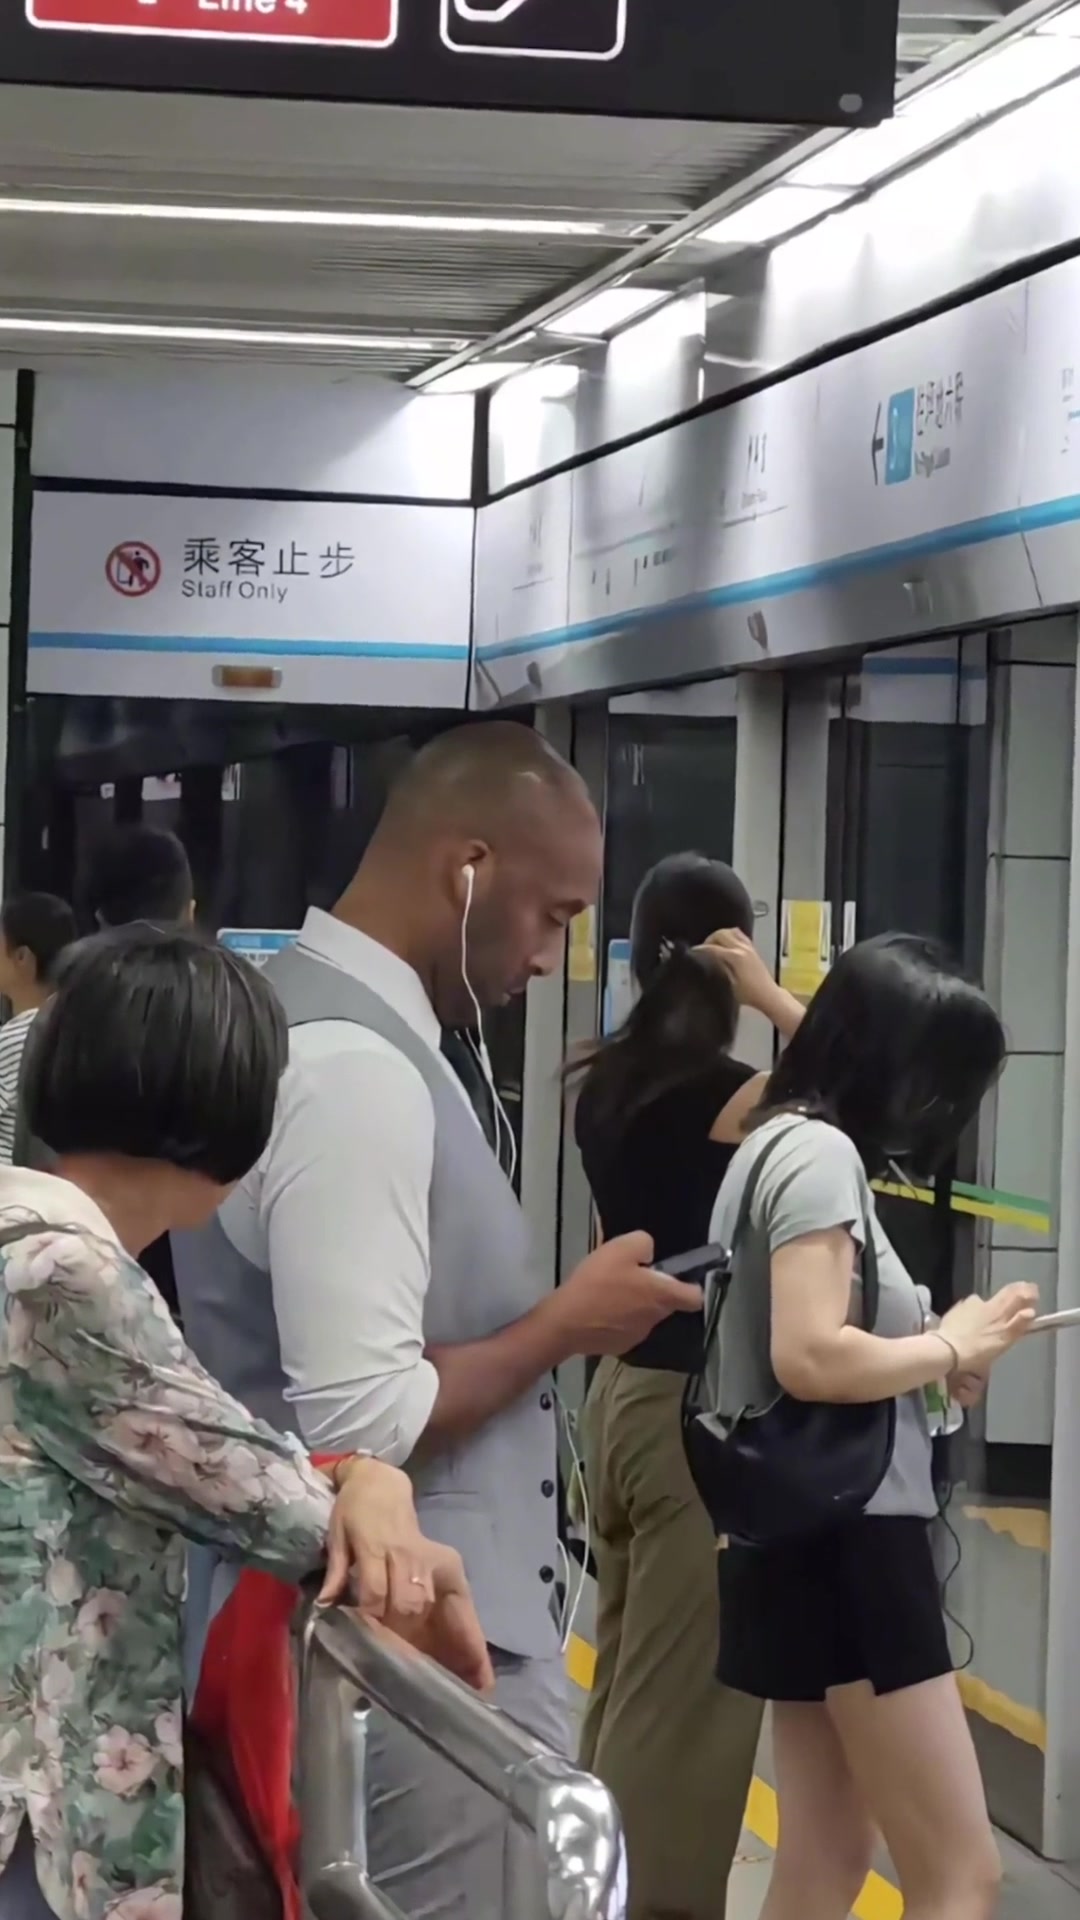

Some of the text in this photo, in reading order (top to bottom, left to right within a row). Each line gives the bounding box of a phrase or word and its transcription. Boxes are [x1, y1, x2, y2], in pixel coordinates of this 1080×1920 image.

[184, 537, 355, 578] 乘客止步
[181, 579, 288, 603] Staff Only
